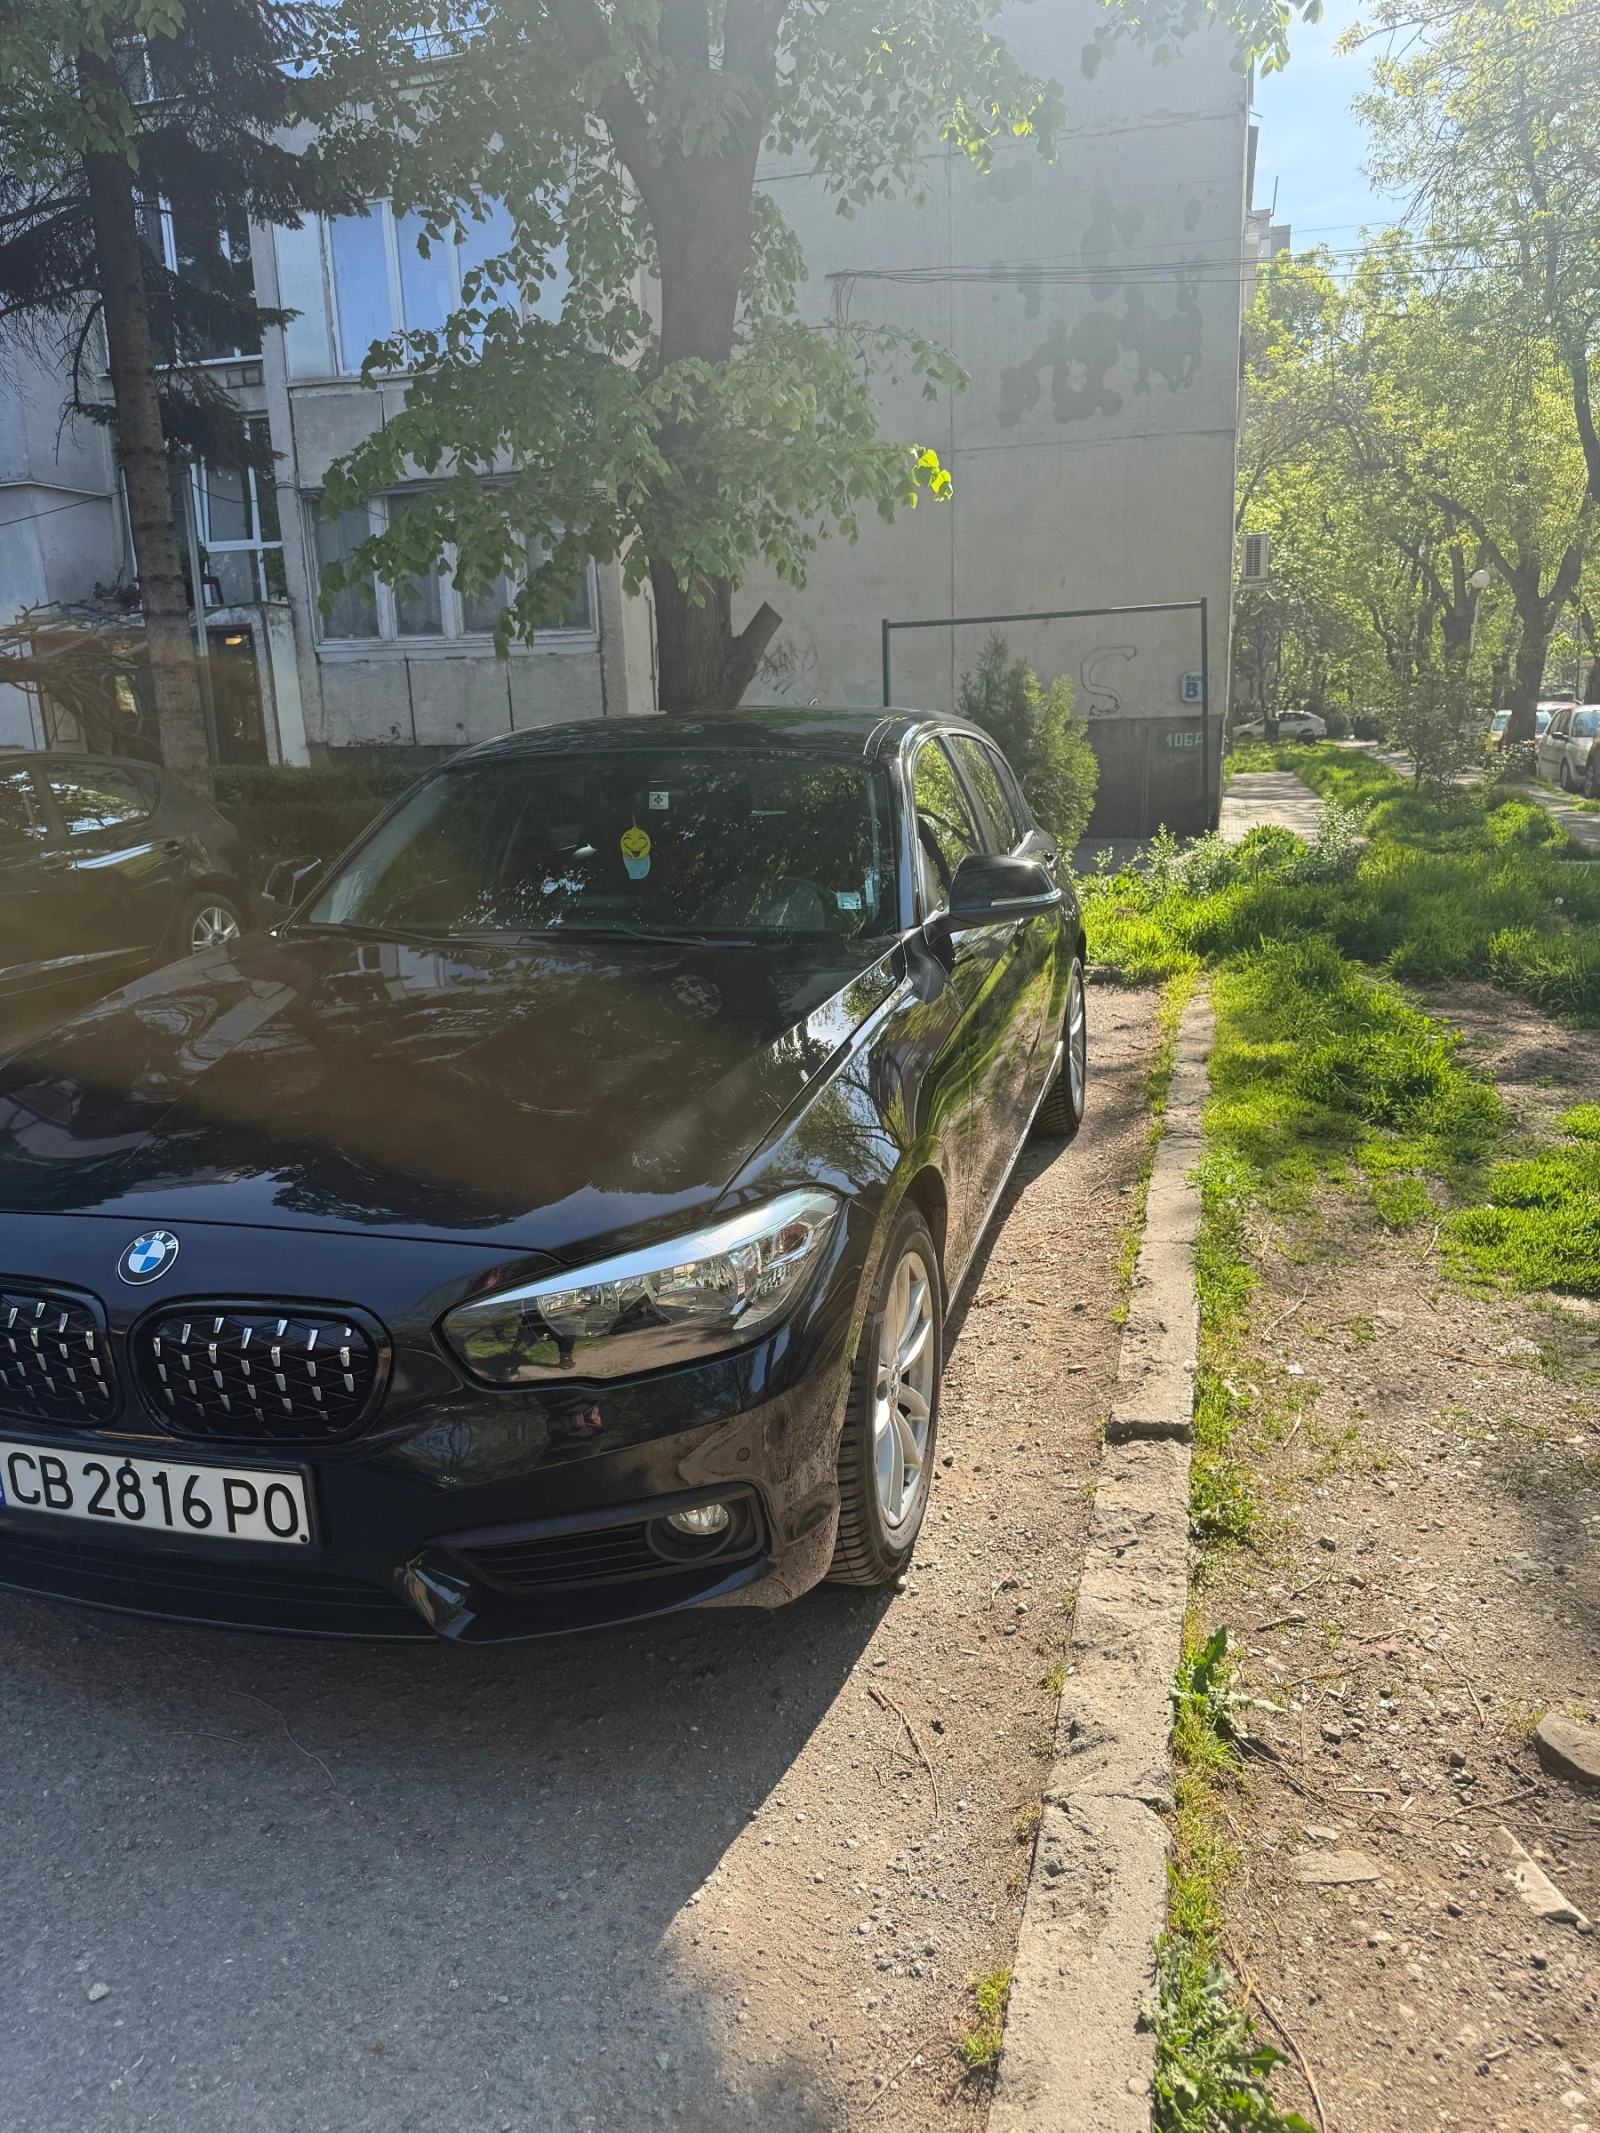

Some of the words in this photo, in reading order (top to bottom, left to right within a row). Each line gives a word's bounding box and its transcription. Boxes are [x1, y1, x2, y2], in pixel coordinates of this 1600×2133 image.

[135, 1232, 176, 1249] BMW
[8, 1452, 74, 1510] CB
[82, 1462, 213, 1530] 2816
[223, 1477, 299, 1538] PO
